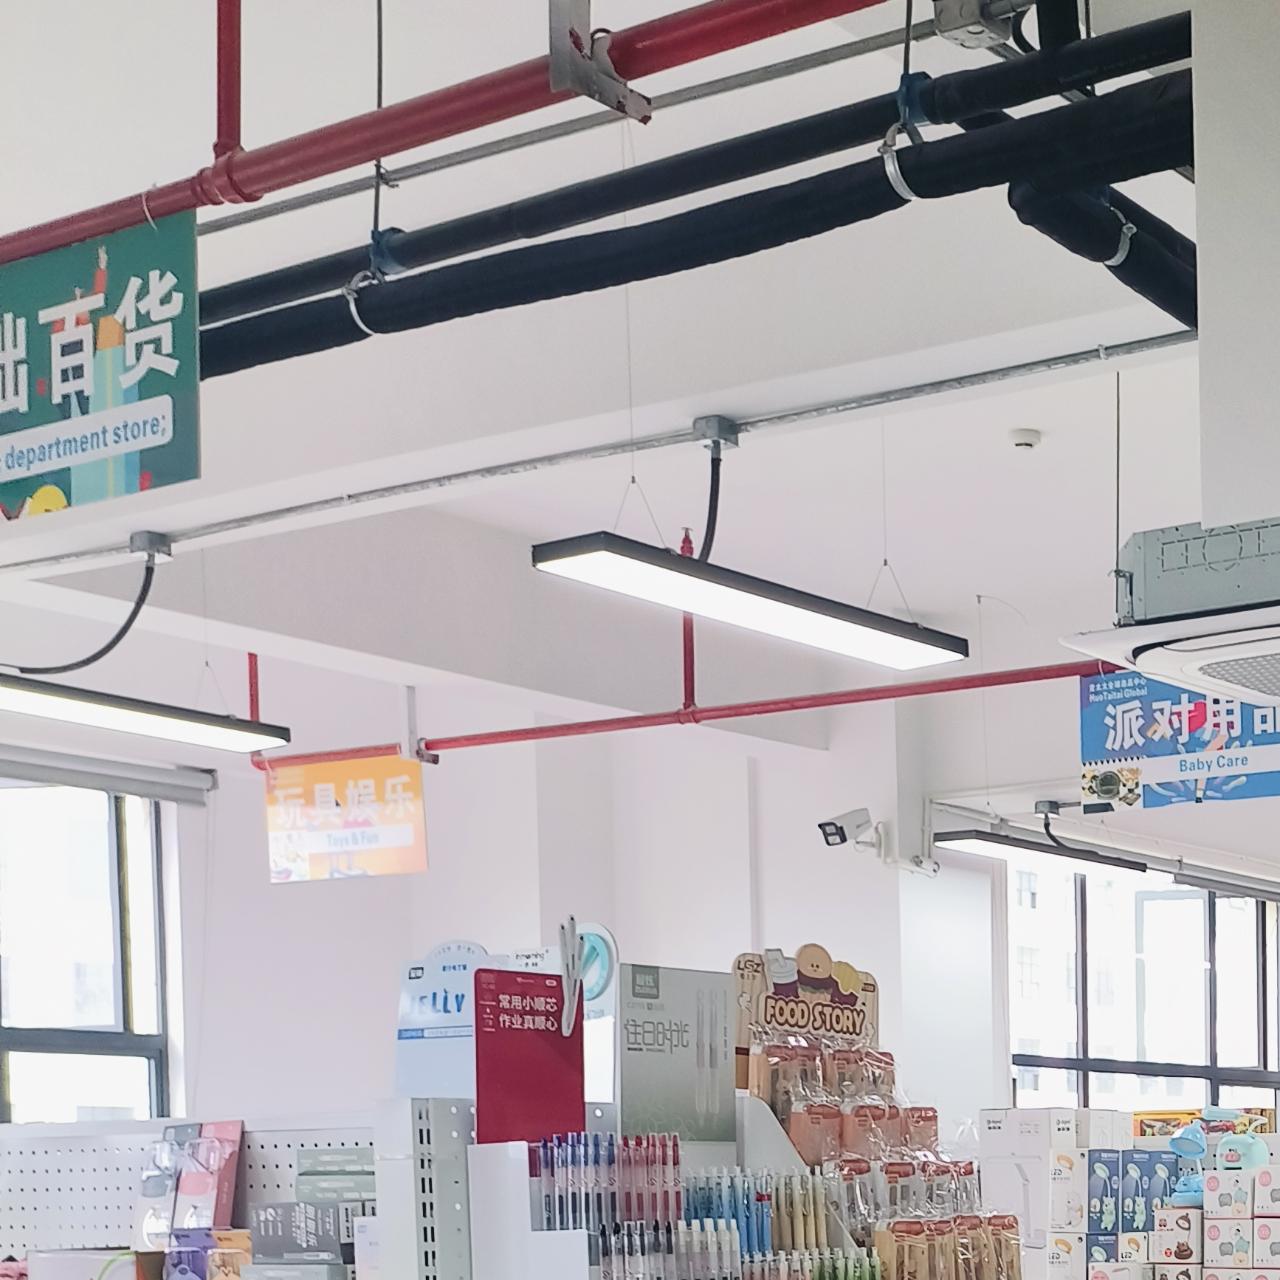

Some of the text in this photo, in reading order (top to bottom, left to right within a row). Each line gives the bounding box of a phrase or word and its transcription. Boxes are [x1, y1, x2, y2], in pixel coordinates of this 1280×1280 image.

[5, 425, 108, 471] department
[1180, 754, 1249, 773] Baby Care
[765, 995, 866, 1036] FOOD STORY
